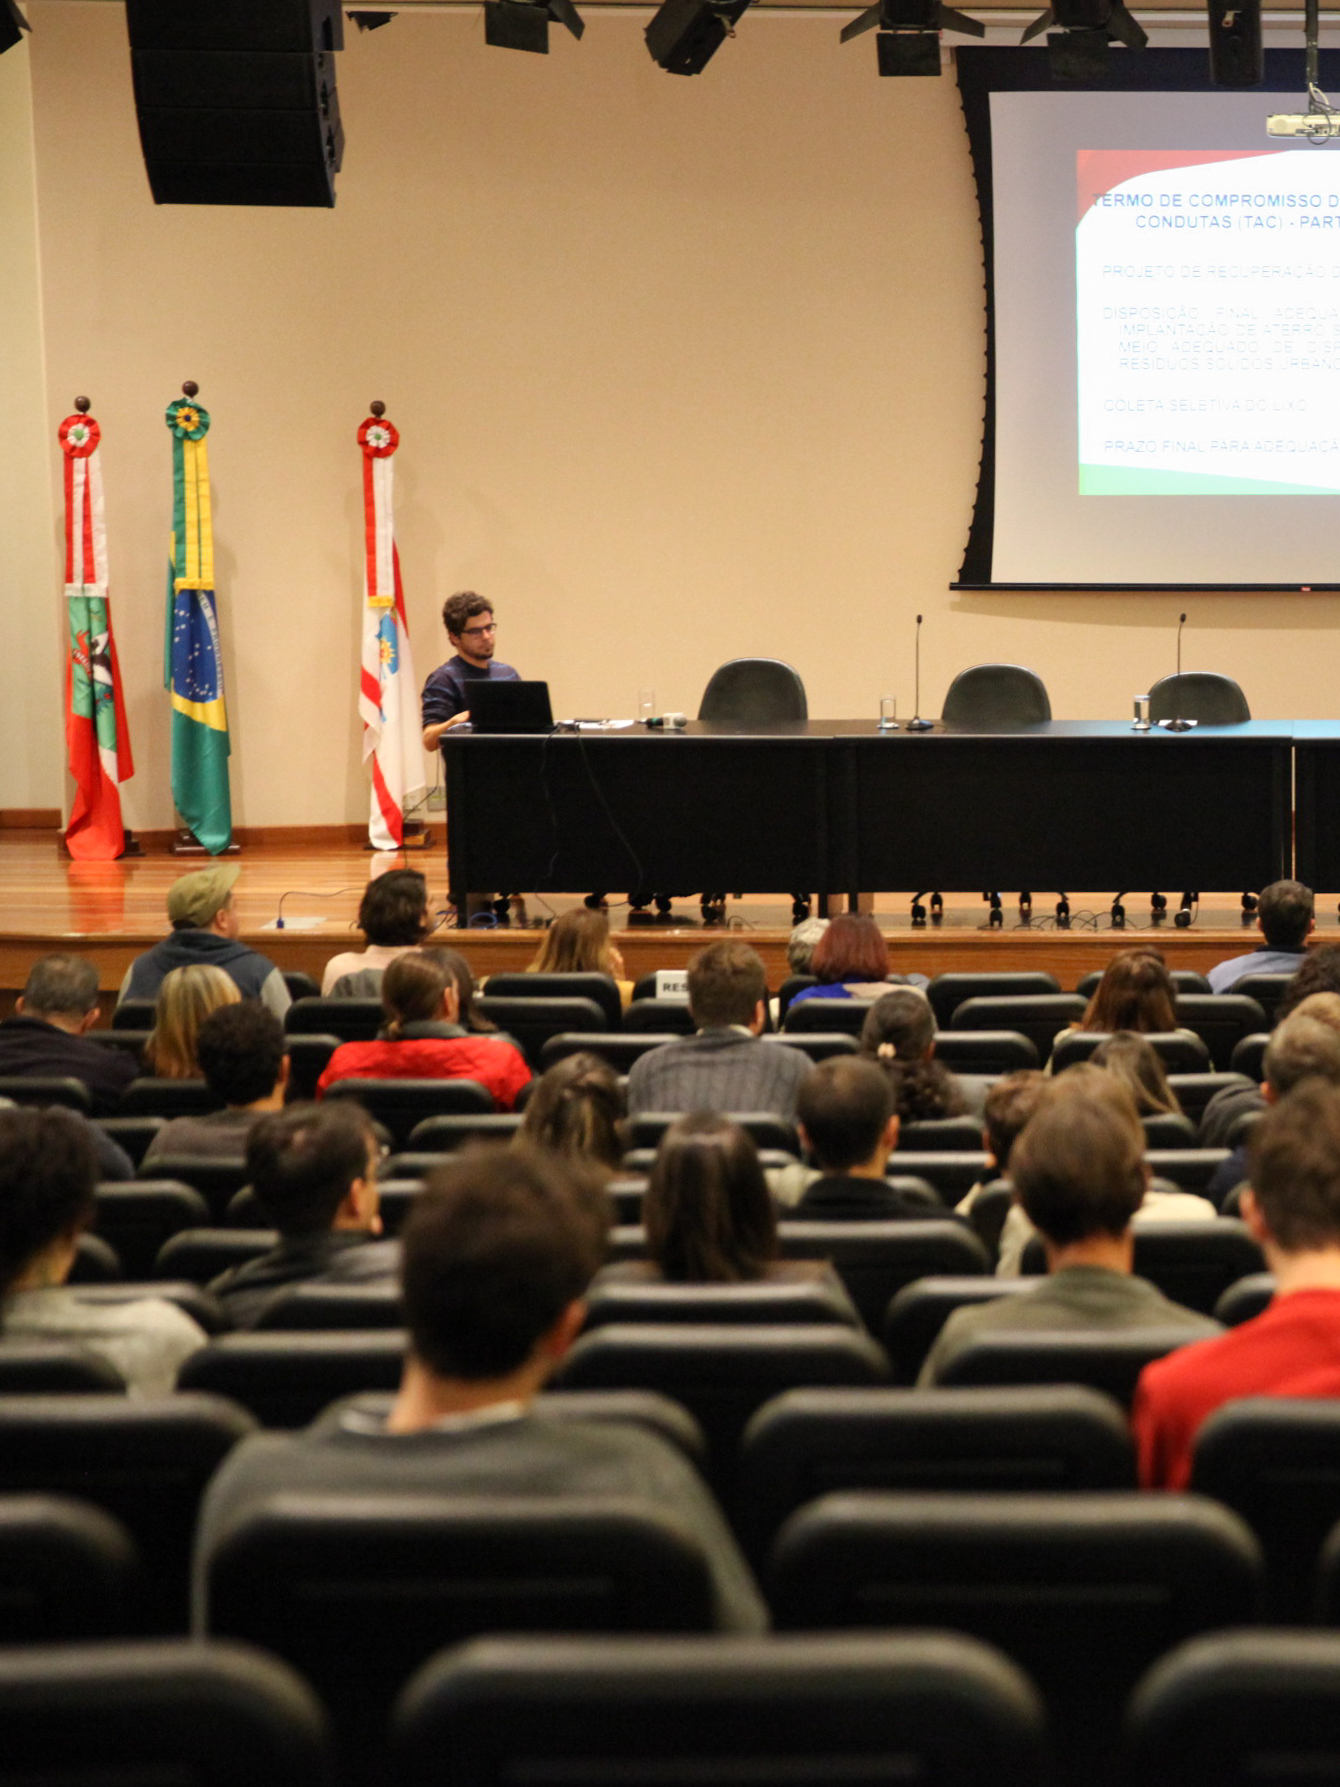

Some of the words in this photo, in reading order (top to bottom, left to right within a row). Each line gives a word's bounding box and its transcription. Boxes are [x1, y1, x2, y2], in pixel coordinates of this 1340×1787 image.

[1092, 193, 1154, 208] TERMO
[1159, 193, 1183, 208] DE
[1188, 193, 1323, 208] COMPROMISSO
[1135, 214, 1233, 229] CONDUTAS
[1237, 214, 1283, 231] (TAC)
[1102, 264, 1176, 279] PROJETO
[1180, 264, 1202, 279] DE
[1206, 262, 1327, 281] RECUPERAÇÃO
[1215, 306, 1259, 320] FINAL
[1236, 323, 1256, 337] DE
[1263, 323, 1325, 337] ATERRO
[1118, 340, 1158, 354] MEIO
[1170, 340, 1260, 355] ADEQUADO
[1272, 340, 1294, 354] DE
[1103, 399, 1165, 412] COLETA
[1169, 399, 1241, 412] SELETIVA
[1245, 399, 1268, 412] DO
[1103, 440, 1158, 453] PRAZO
[1162, 440, 1206, 453] FINAL
[1210, 440, 1250, 453] PARA
